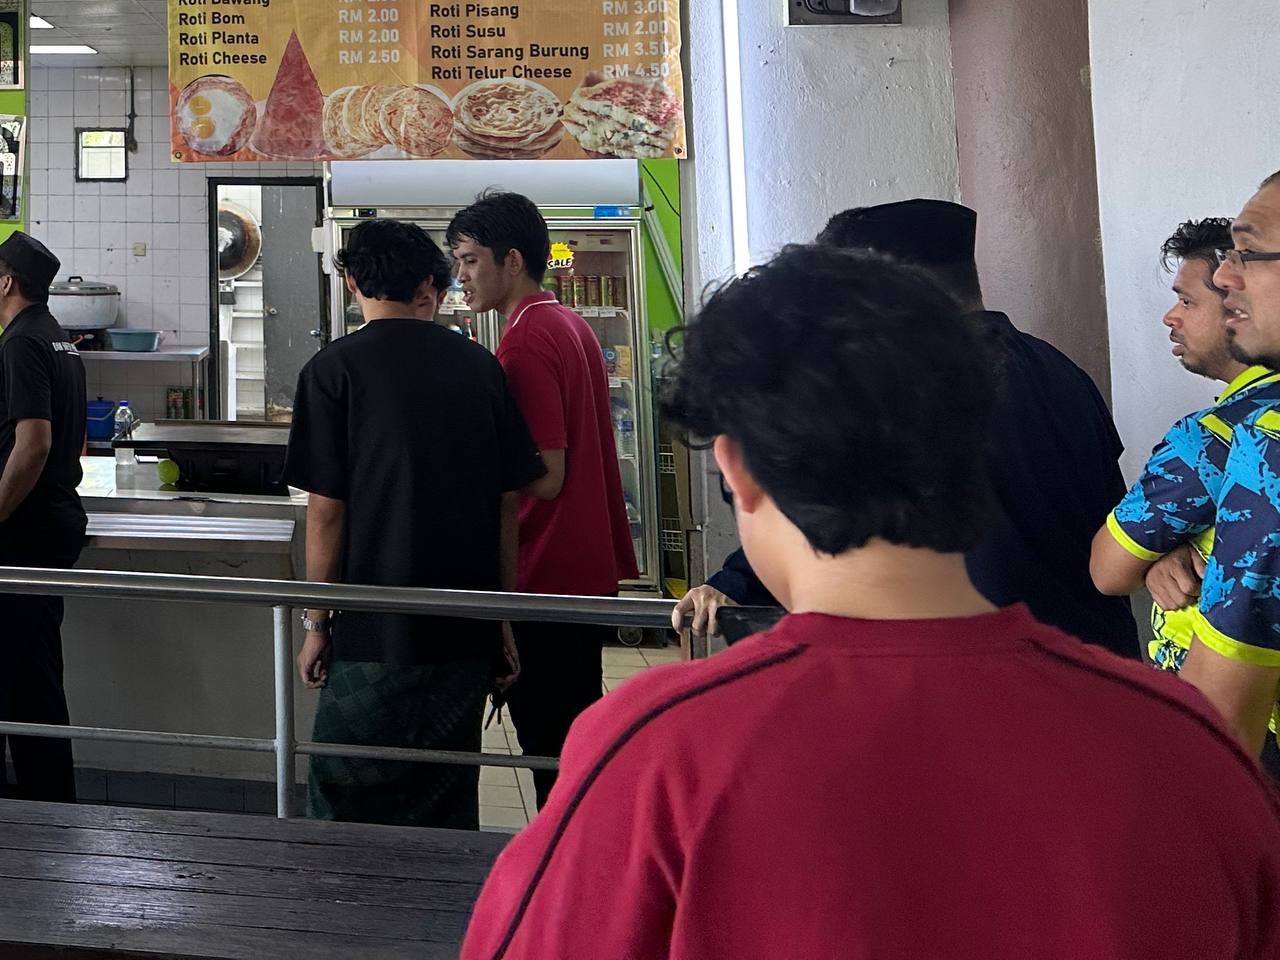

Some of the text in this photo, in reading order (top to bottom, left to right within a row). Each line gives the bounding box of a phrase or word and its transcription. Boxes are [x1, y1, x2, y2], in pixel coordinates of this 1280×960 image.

[179, 8, 398, 25] Roti Bom RM 2.00
[430, 0, 668, 18] Roti Pisang RM 3.00
[179, 29, 399, 45] Roti Planta RM 2.00
[431, 21, 668, 38] Roti Susu RM 2.00
[180, 49, 400, 65] Roti Cheese RM 2.50
[431, 42, 669, 60] Roti Sarang Burung RM 3.50
[431, 63, 669, 79] Roti Telur Cheese RM 4.50
[547, 258, 571, 268] SALE
